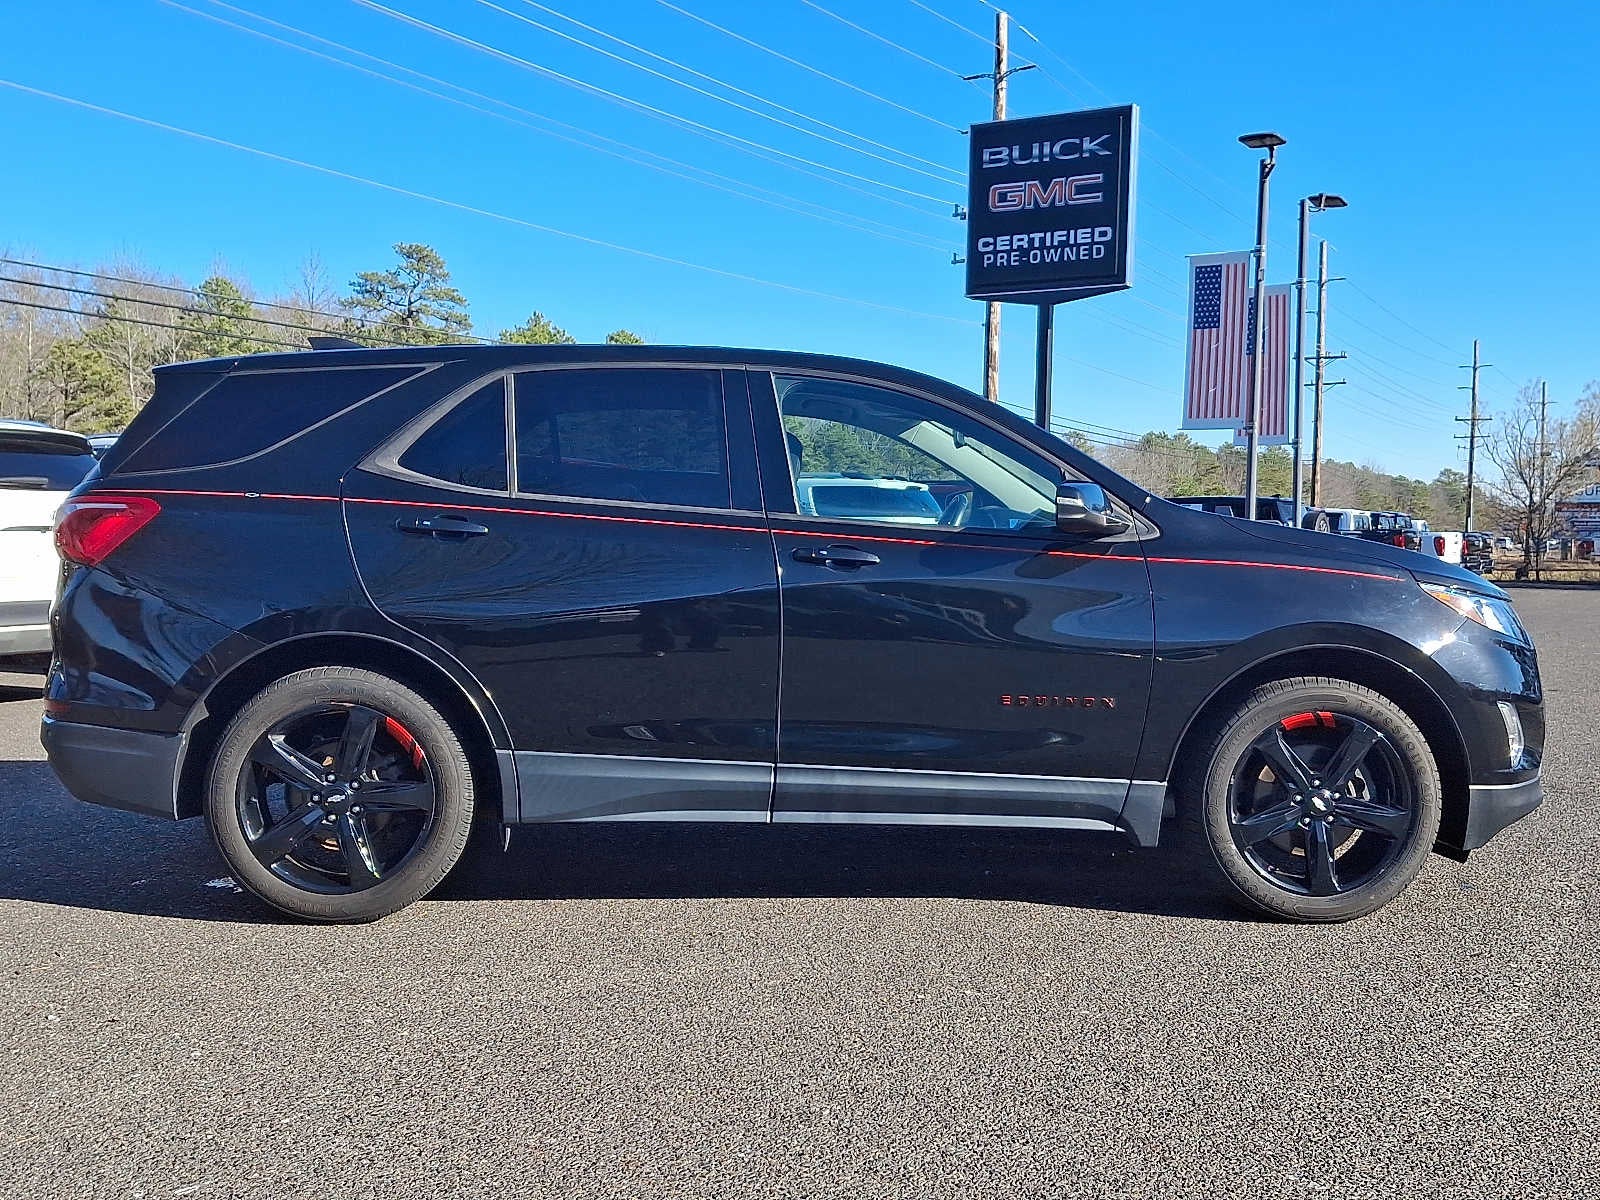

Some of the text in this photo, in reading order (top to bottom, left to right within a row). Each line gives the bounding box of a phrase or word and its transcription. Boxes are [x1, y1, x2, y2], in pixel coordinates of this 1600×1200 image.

[982, 134, 1112, 168] BUICK
[988, 173, 1103, 212] GMC
[977, 227, 1112, 252] CERTIFIED
[983, 244, 1105, 268] PRE-OWNED
[1001, 695, 1116, 707] EQUINOX
